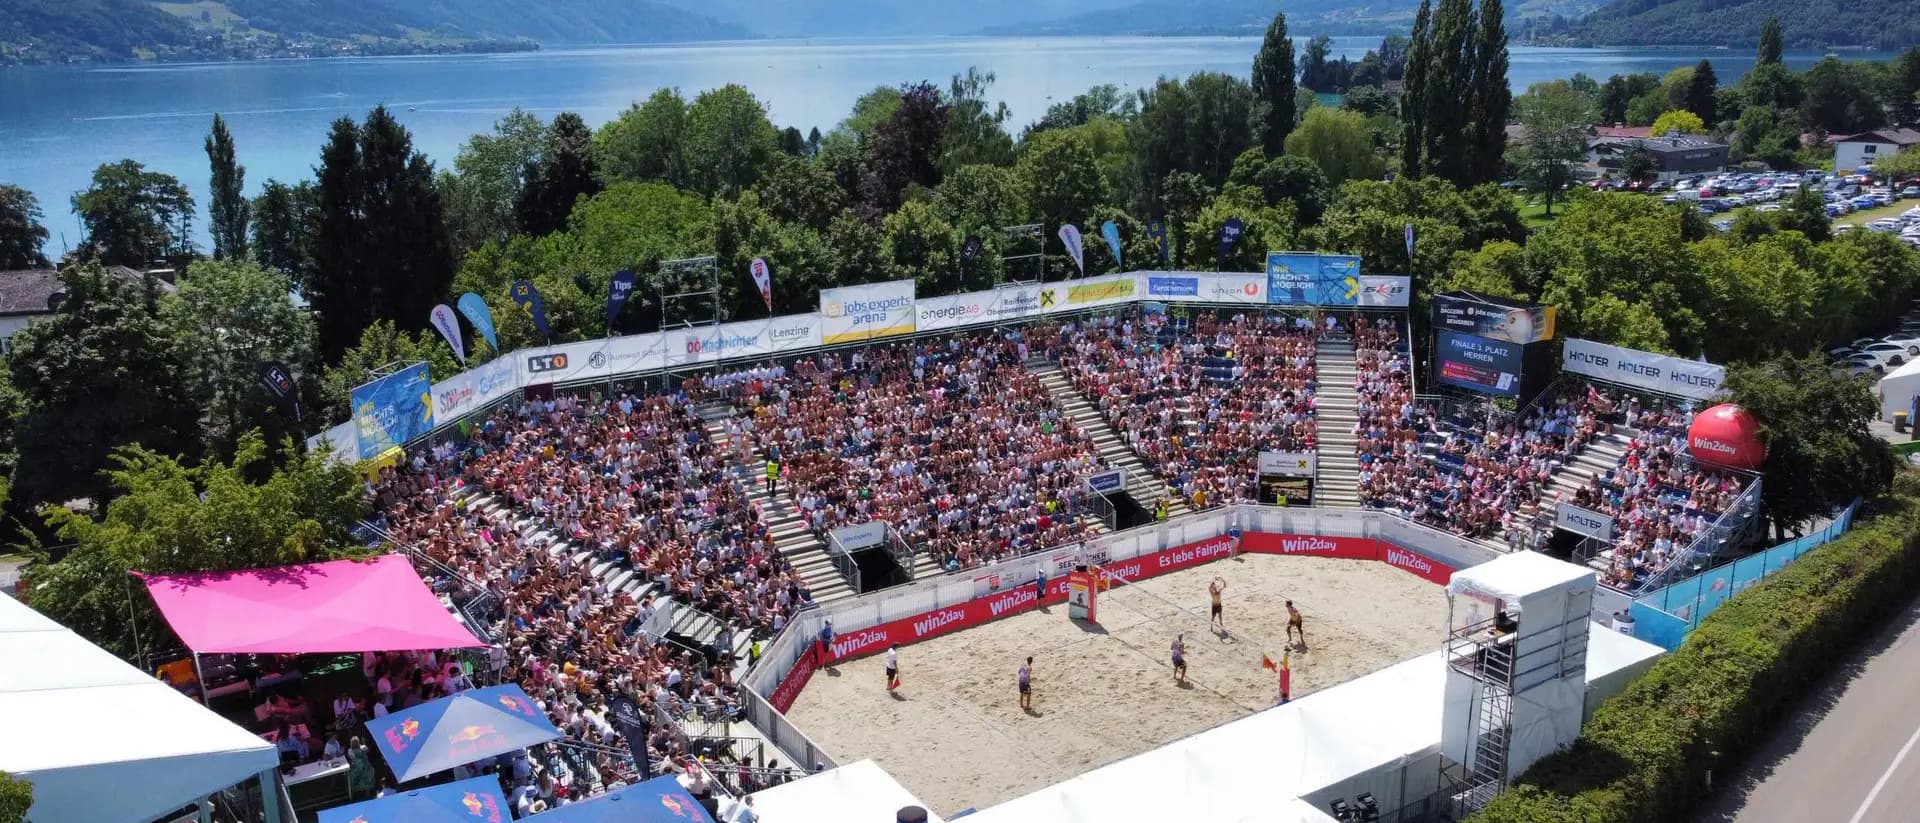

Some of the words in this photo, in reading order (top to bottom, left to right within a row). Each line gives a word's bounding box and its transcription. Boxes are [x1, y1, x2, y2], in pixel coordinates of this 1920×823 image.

[1225, 226, 1239, 236] Tips
[614, 280, 632, 292] Tips
[844, 300, 868, 314] jobs
[869, 296, 911, 312] experts
[853, 311, 887, 325] arena
[774, 326, 809, 338] Lenzing
[1450, 339, 1477, 350] FINALE
[1485, 345, 1510, 357] PLATZ
[1463, 351, 1494, 363] HERREN
[1569, 350, 1609, 368] HOLTER
[1617, 360, 1661, 379] HOLTER
[1670, 370, 1717, 389] HOLTER
[1566, 513, 1603, 531] HOLTER
[1159, 554, 1172, 567] Es
[1173, 549, 1194, 563] lebe
[1196, 537, 1232, 558] Fairplay
[1281, 536, 1337, 553] win2day
[1387, 547, 1432, 574] win2day
[1060, 582, 1072, 594] Es
[1100, 563, 1141, 580] Fairplay
[989, 590, 1038, 616] win2day
[914, 608, 965, 637] win2day
[832, 629, 887, 659] win2day
